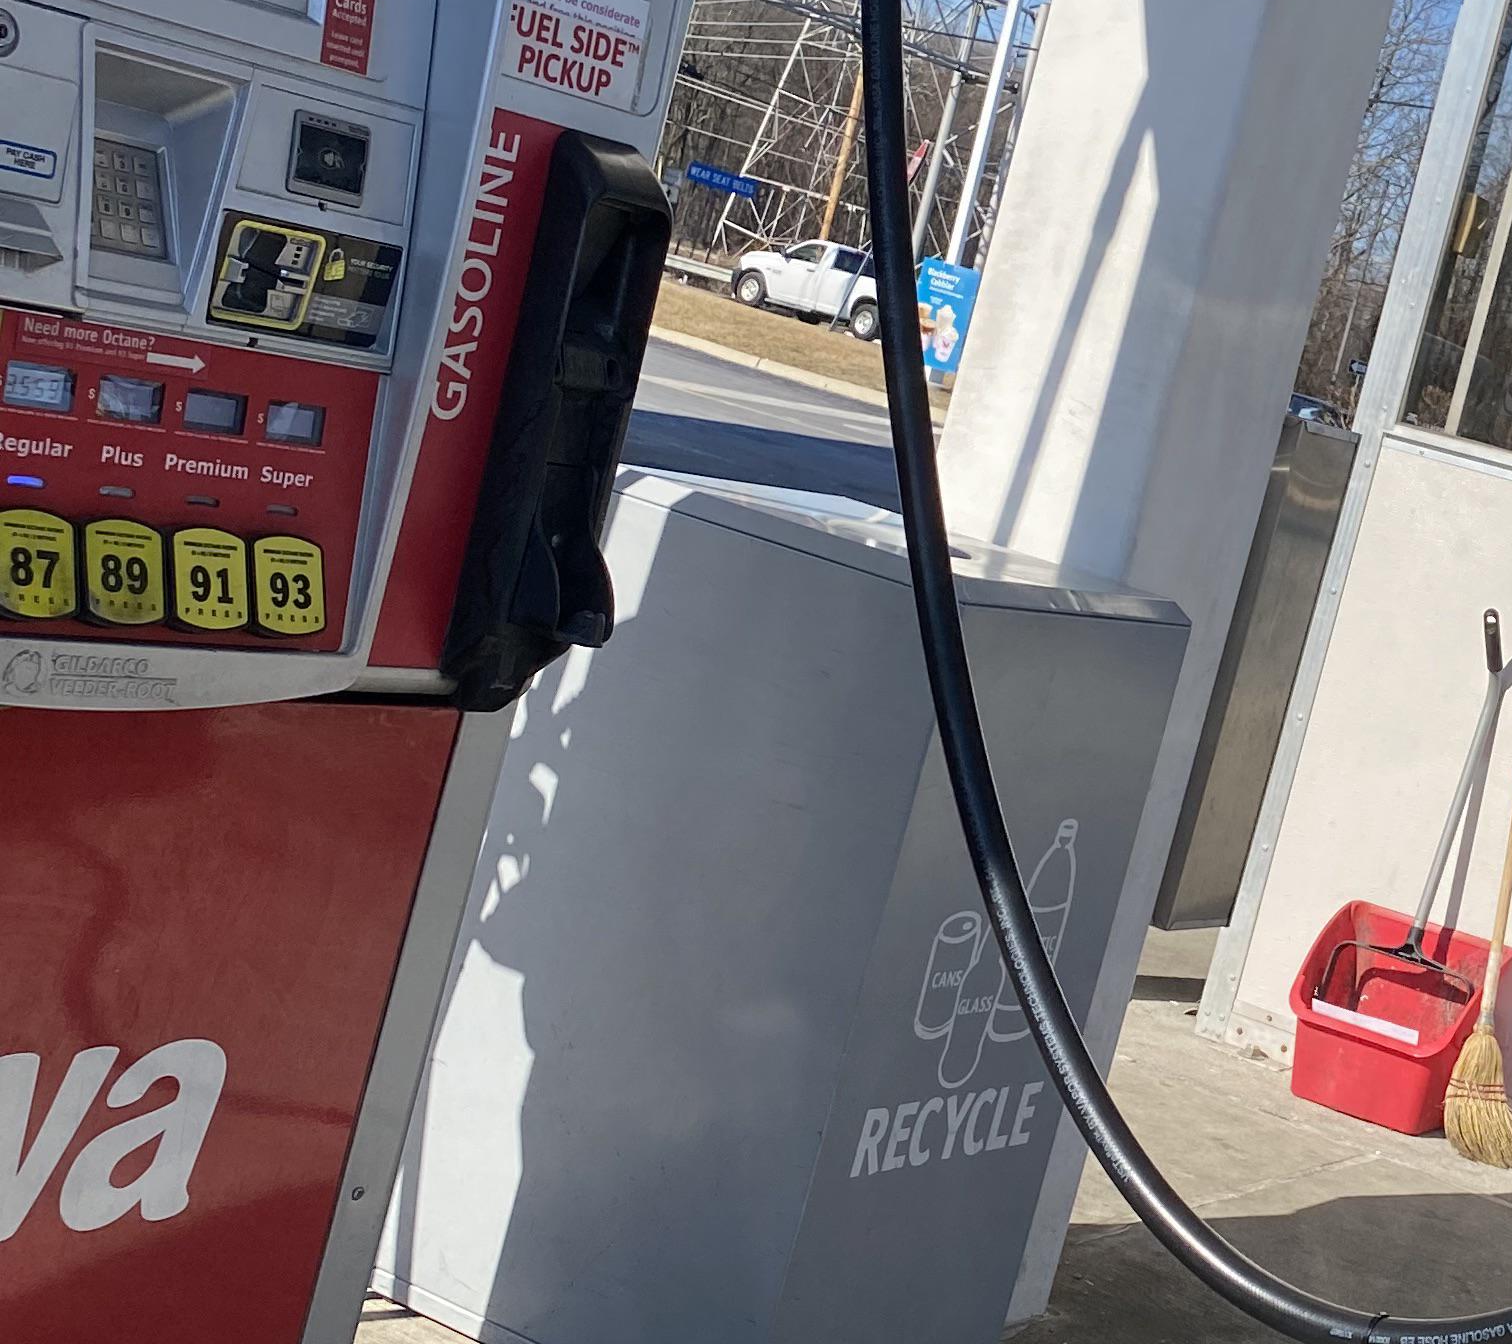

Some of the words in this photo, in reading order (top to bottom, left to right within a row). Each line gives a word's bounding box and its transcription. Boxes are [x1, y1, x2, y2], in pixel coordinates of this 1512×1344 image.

[332, 8, 367, 27] Accepted
[510, 3, 564, 49] UEL
[518, 44, 612, 96] PICKUP
[690, 166, 711, 180] WEAR
[712, 173, 731, 186] SEAT
[431, 132, 521, 421] GASOLINE
[24, 317, 60, 336] Need
[64, 328, 99, 343] more
[102, 330, 156, 350] Octane?
[101, 445, 144, 467] Plus
[165, 453, 248, 480] Premium
[260, 466, 314, 489] Super
[10, 546, 60, 589] 87
[101, 554, 148, 595] 89
[190, 565, 234, 605] 91
[270, 572, 313, 610] 93
[52, 654, 149, 675] GILBARCO
[50, 678, 177, 702] VEEDER-ROOT
[932, 970, 962, 991] CANS
[958, 997, 994, 1016] GLASS
[849, 1080, 1045, 1178] RECYCLE
